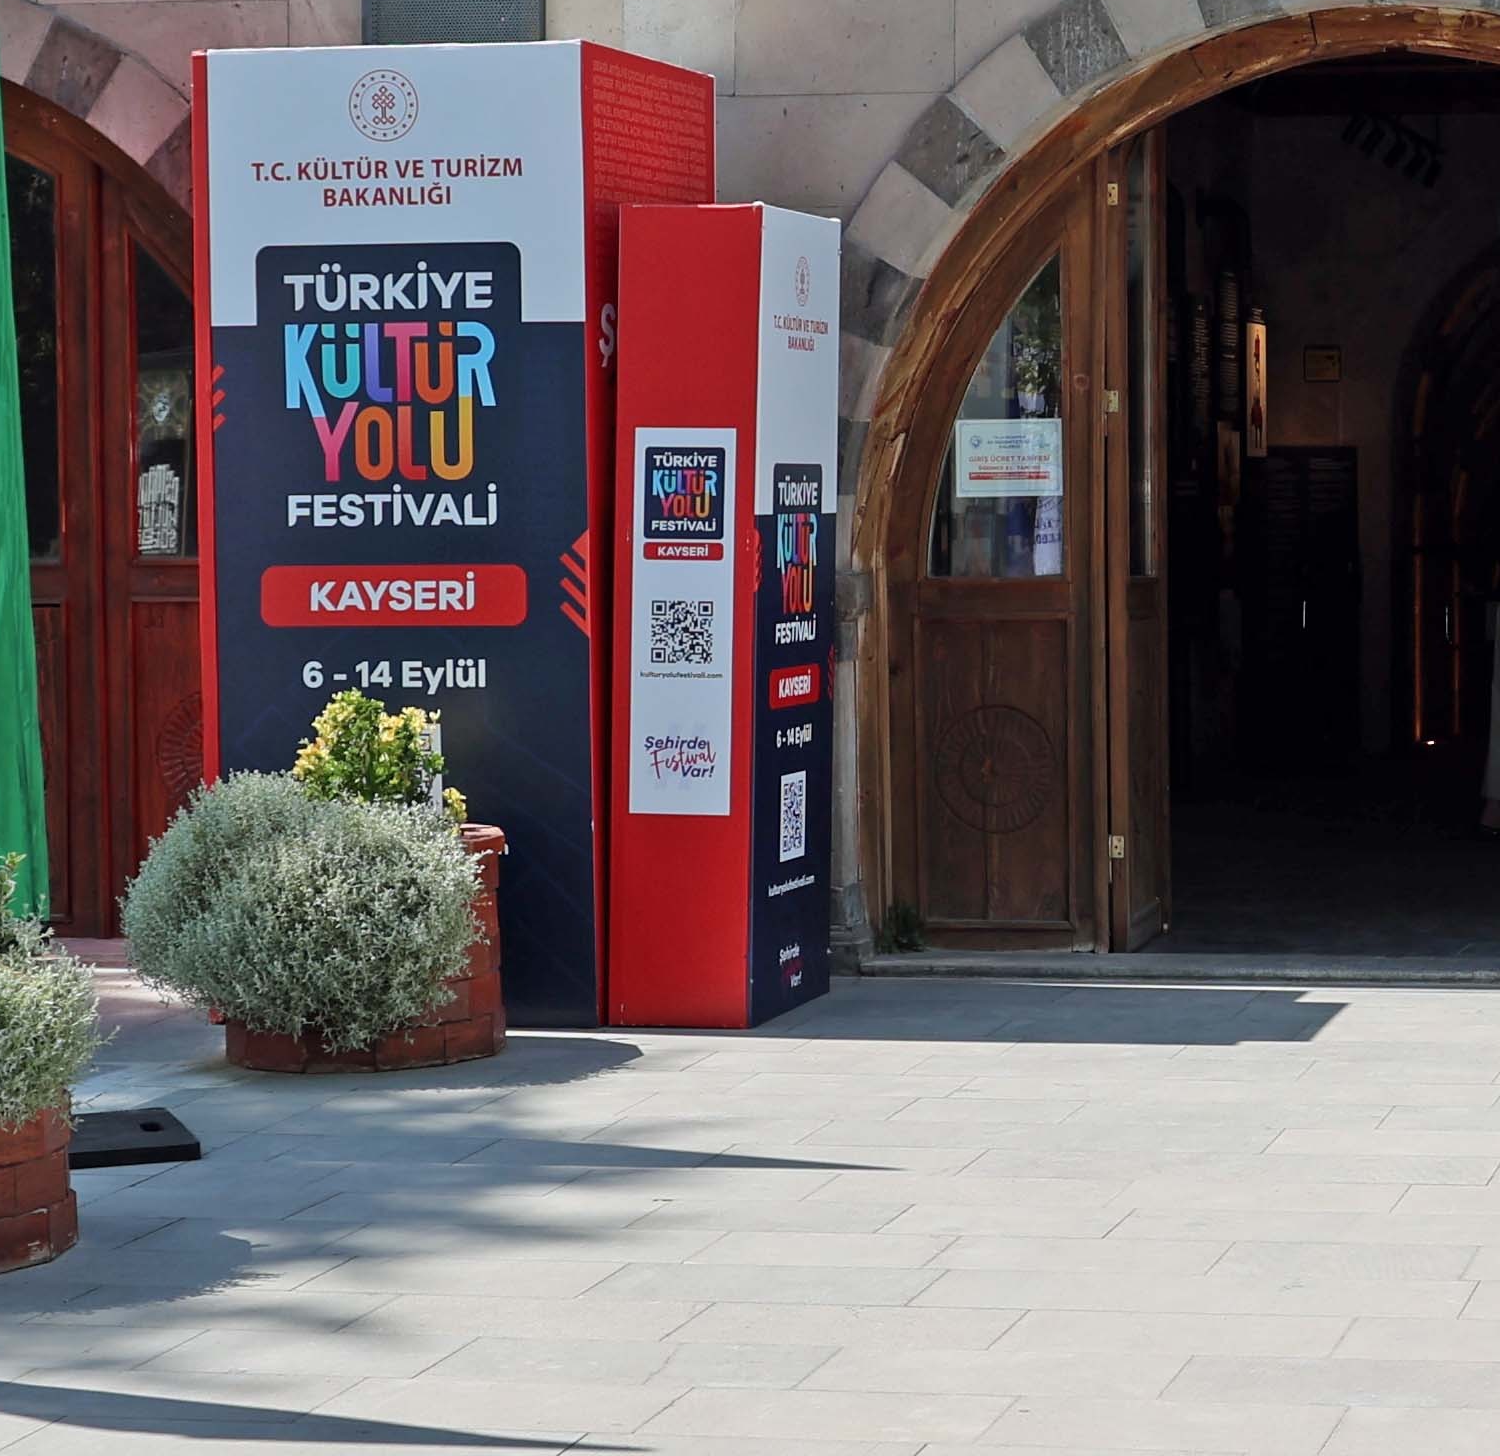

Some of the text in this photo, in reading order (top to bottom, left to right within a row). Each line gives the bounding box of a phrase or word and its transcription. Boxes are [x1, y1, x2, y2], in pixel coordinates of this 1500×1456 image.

[251, 153, 524, 182] T.C. KÜLTÜR VE TURİZM
[323, 182, 452, 207] BAKANLIĞI
[283, 260, 493, 312] TÜRKİYE
[285, 322, 497, 417] KÜLTÜR
[312, 397, 474, 482] YOLU
[653, 451, 718, 468] TÜRKİYE
[652, 468, 718, 499] KÜLTÜR
[778, 474, 818, 508] TÜRKİYE
[288, 483, 498, 528] FESTİVALİ
[661, 491, 710, 518] YOLU
[651, 516, 717, 533] FESTİVALİ
[657, 542, 709, 557] KAYSERİ
[777, 511, 818, 571] KÜLTÜR
[310, 572, 476, 611] KAYSERİ
[775, 617, 816, 645] FESTİVALİ
[302, 661, 323, 688] 6
[356, 662, 393, 688] 14
[402, 659, 487, 695] Eylül
[778, 672, 812, 698] KAYSERİ
[644, 736, 707, 751] Şehirde
[776, 731, 782, 748] 6
[796, 724, 812, 750] Eylül
[650, 741, 716, 779] Festival
[681, 765, 714, 778] Var!
